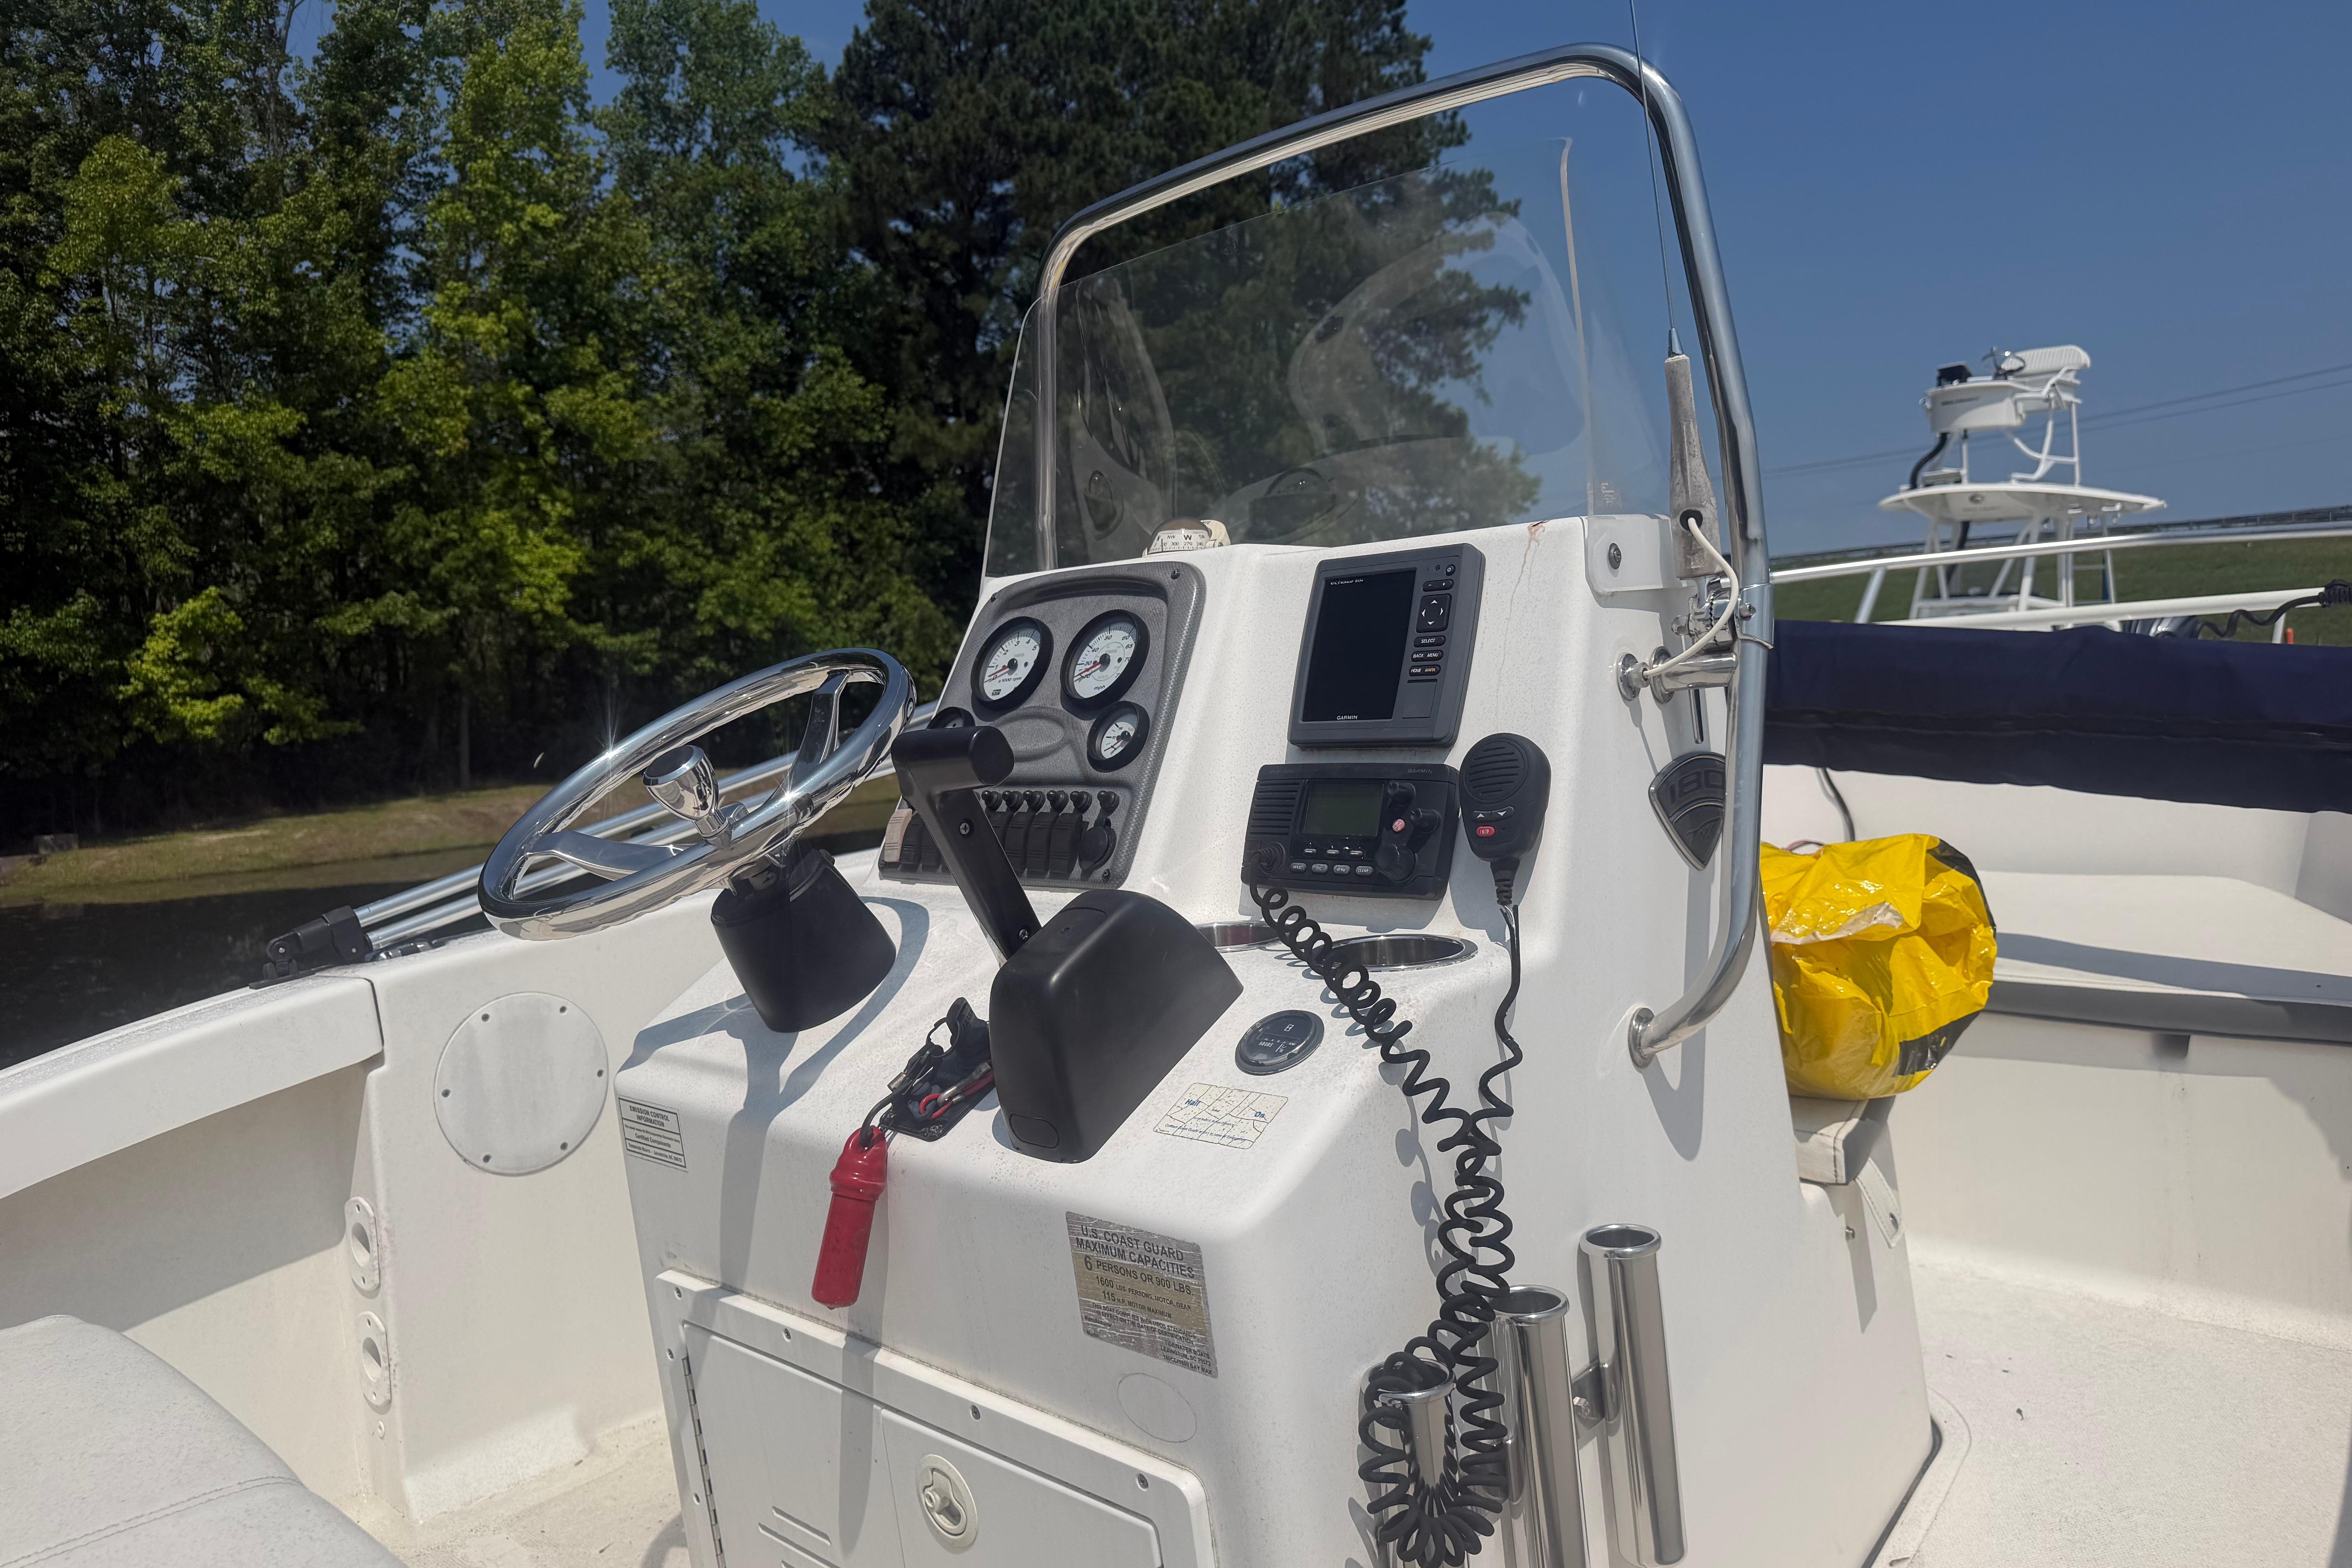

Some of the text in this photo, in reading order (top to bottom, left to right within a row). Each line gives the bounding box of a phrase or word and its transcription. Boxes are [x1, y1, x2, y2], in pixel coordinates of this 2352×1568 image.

[630, 1105, 670, 1122] EMISSION CONTROL
[637, 1115, 665, 1127] INFORMATION
[1081, 1225, 1183, 1261] U.S. COAST GUARD
[1076, 1237, 1195, 1279] MAXIMUM CAPACITIES
[1084, 1255, 1194, 1296] 6 PERSONS OR 900 LBS.
[1096, 1276, 1113, 1288] 1600
[1128, 1288, 1154, 1301] PERSONS,
[1155, 1296, 1176, 1308] MOTOR,
[1176, 1302, 1192, 1311] GEAR
[1102, 1290, 1116, 1302] 115
[1128, 1301, 1146, 1311] MOTOR
[1147, 1307, 1172, 1318] MAXIMUM
[1102, 1312, 1119, 1321] EFFECT
[1158, 1329, 1194, 1345] CERTIFICATION
[1167, 1325, 1196, 1339] STANDARDS
[1164, 1340, 1210, 1359] TIDEWATER BOATS
[1190, 1363, 1200, 1371] BAY
[1201, 1367, 1212, 1375] MAX
